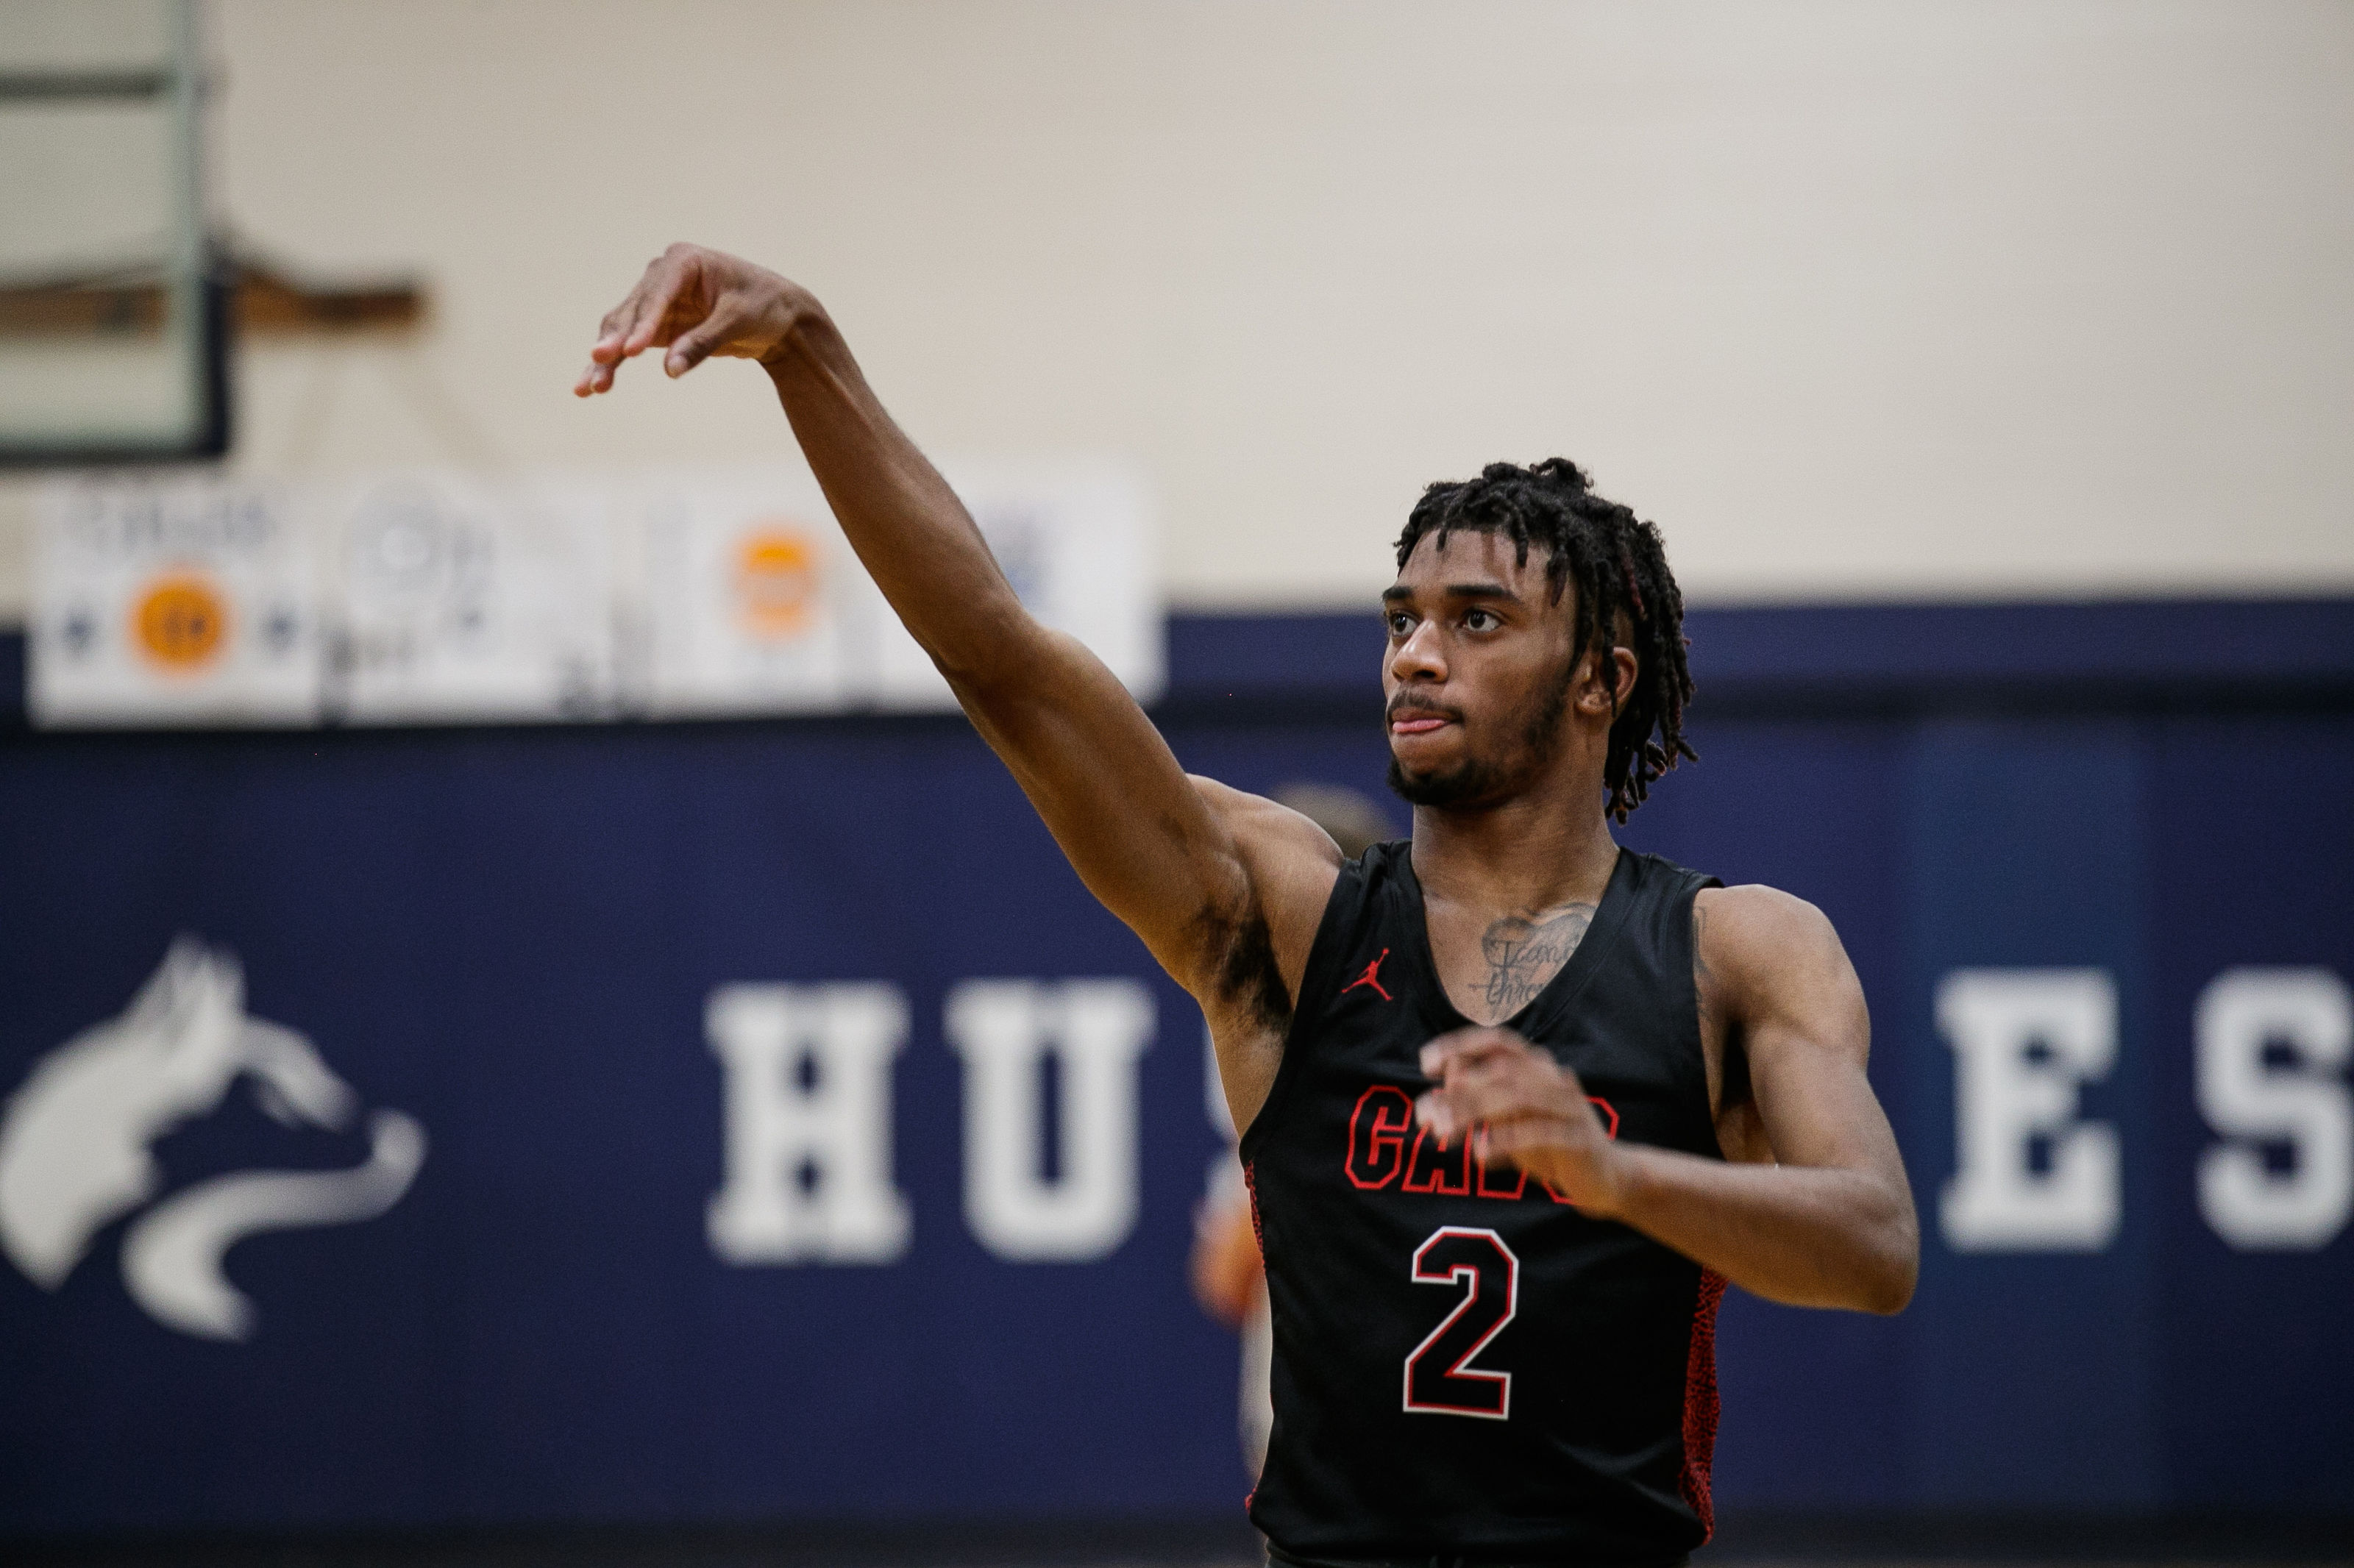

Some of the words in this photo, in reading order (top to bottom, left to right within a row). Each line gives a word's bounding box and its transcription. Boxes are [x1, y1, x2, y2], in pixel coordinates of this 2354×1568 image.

[703, 966, 2354, 1266] HUES
[1345, 1085, 1619, 1204] CA
[1404, 1226, 1518, 1419] 2
